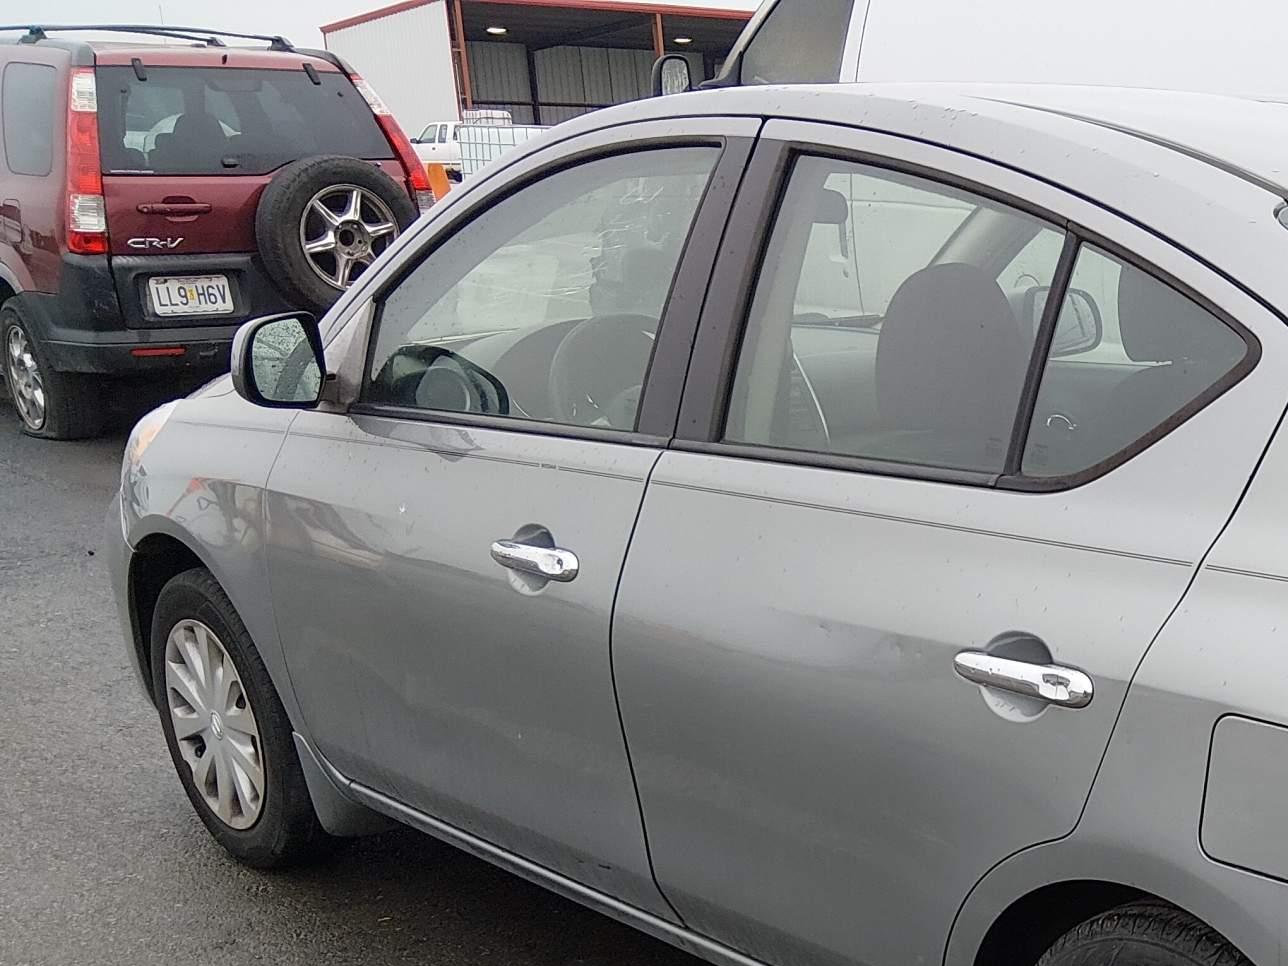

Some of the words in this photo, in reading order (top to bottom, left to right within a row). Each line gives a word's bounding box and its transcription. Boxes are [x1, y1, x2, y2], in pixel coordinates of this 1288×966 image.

[127, 237, 184, 249] CR-V
[155, 286, 189, 307] LL9
[194, 284, 227, 306] H6V
